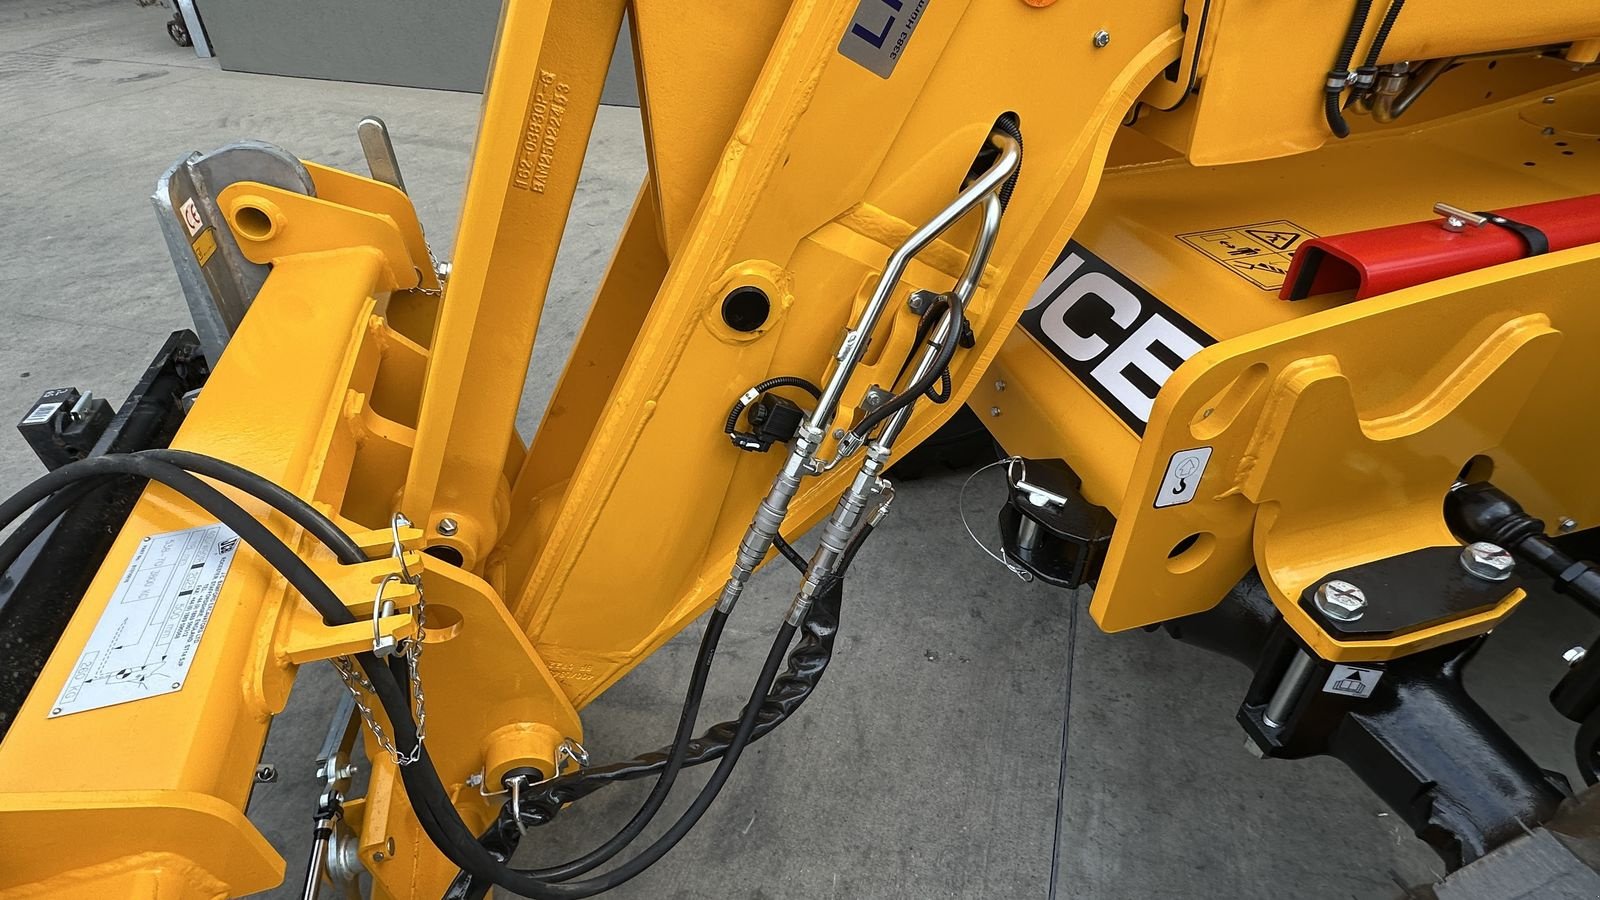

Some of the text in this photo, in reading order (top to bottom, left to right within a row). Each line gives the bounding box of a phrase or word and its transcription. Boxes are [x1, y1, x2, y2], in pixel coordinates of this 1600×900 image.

[890, 32, 907, 59] 3383
[169, 602, 185, 620] 500
[63, 684, 80, 699] KG
